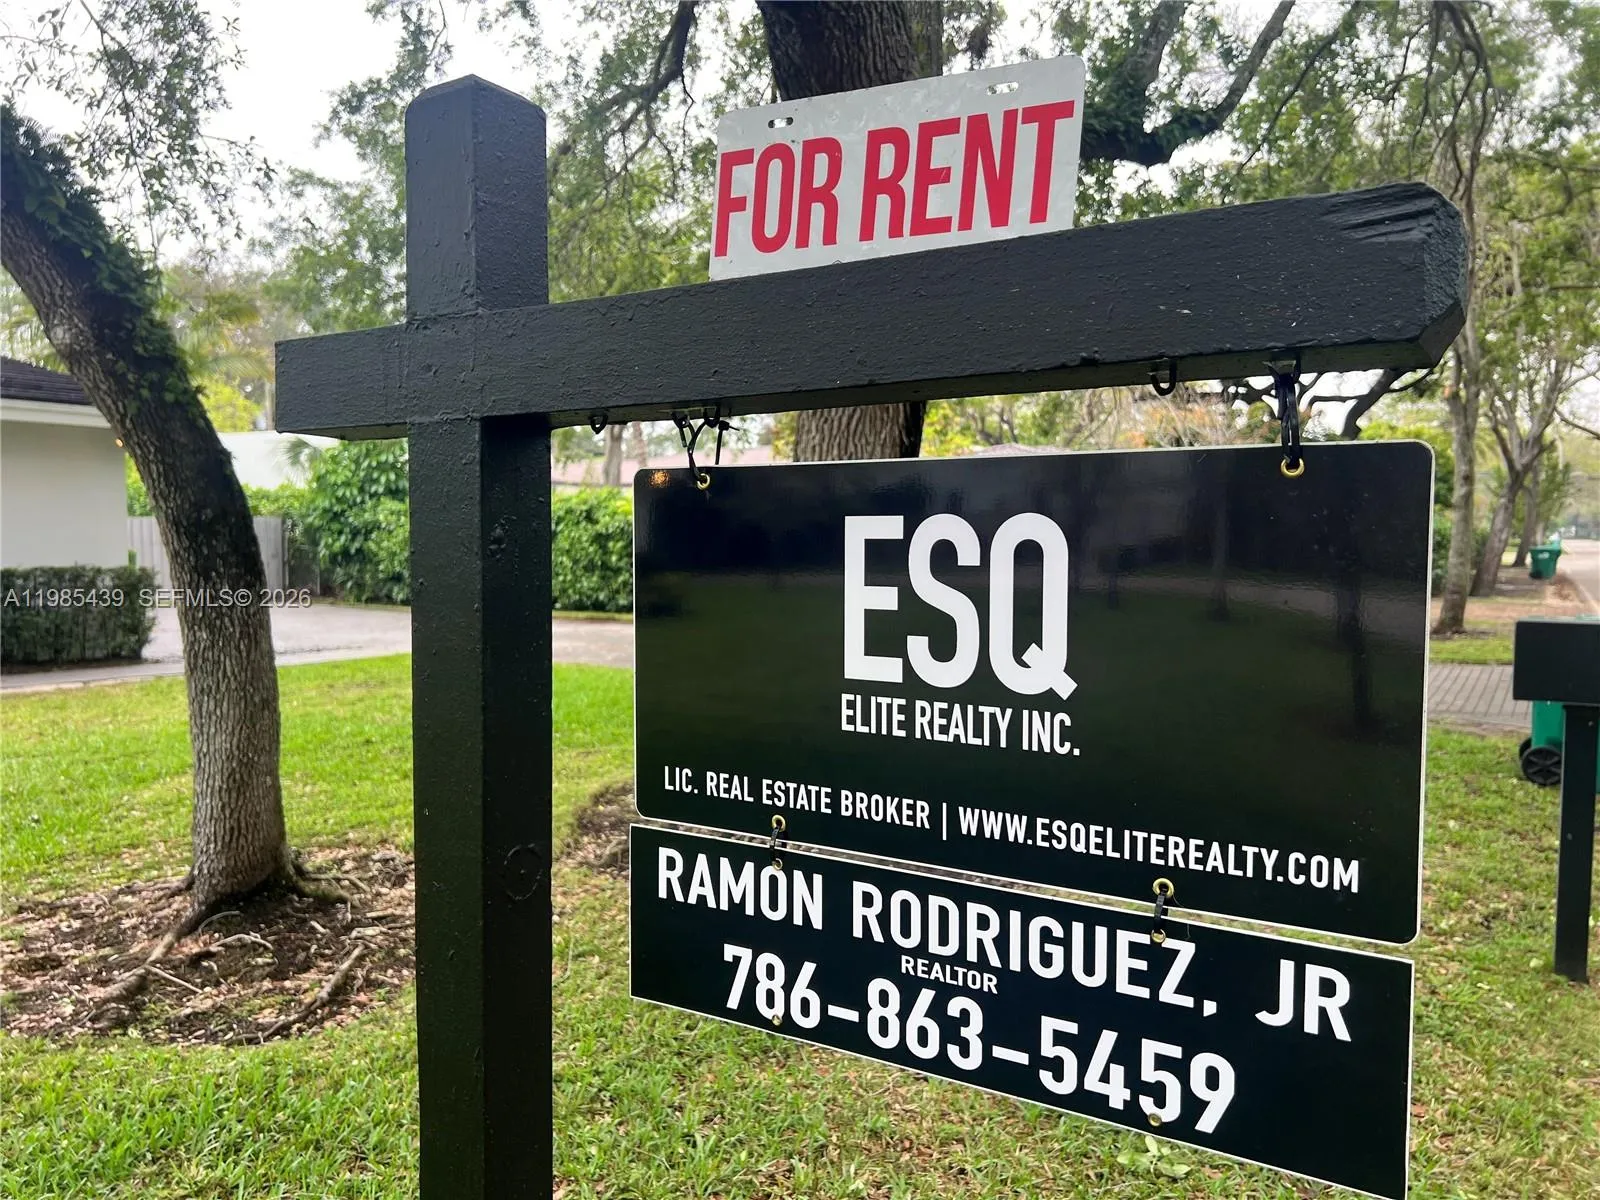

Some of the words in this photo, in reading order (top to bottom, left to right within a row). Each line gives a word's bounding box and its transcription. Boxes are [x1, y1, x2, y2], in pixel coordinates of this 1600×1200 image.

[715, 136, 843, 258] FOR
[859, 100, 1075, 242] RENT
[843, 512, 1078, 701] ESQ
[841, 693, 907, 738] ELITE
[915, 699, 1013, 749] REALTY
[1022, 709, 1081, 757] INC.
[664, 765, 700, 797] LIC.
[706, 771, 755, 804] REAL
[762, 778, 832, 815] ESTATE
[840, 789, 931, 830] BROKER
[958, 805, 1360, 894] WWW.ESQELITEREALTY.COM
[657, 846, 824, 931] RAMON
[852, 880, 1218, 1017] RODRIGUEZ,
[1254, 957, 1353, 1042] JR
[901, 954, 999, 995] REALTOR
[723, 943, 1237, 1134] 786-863-5459
